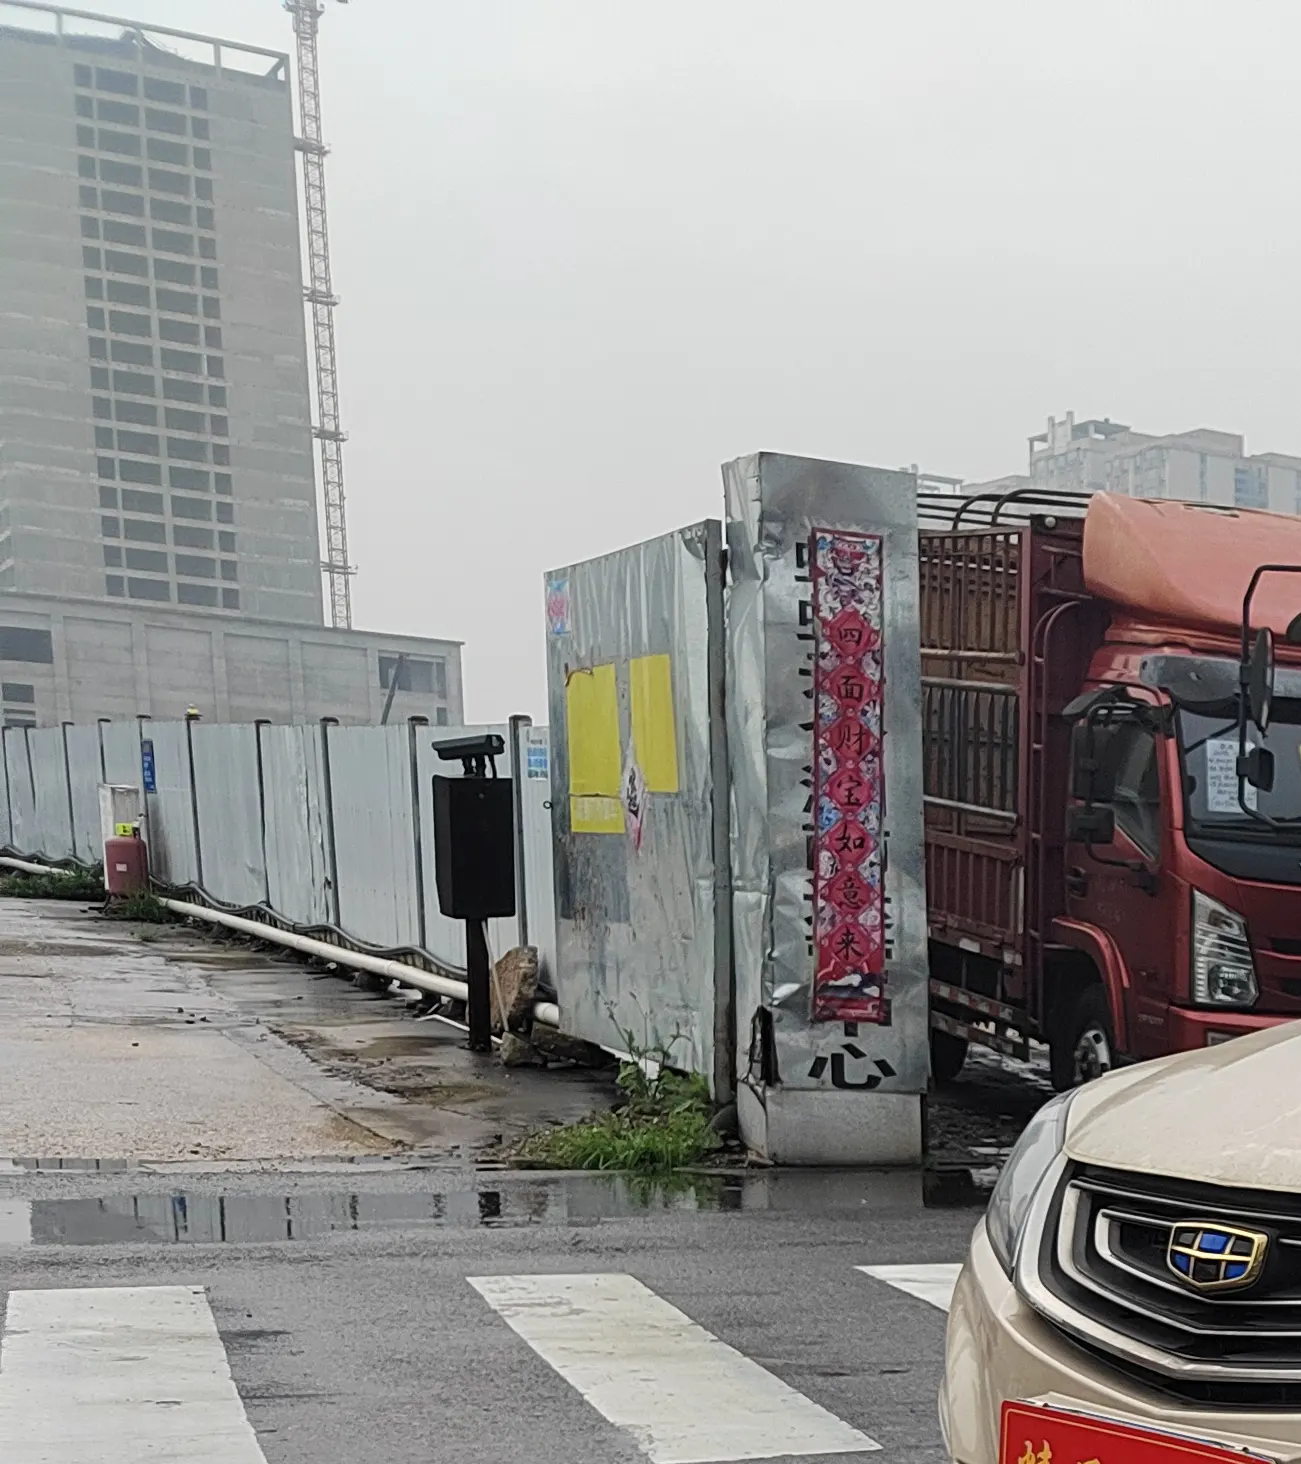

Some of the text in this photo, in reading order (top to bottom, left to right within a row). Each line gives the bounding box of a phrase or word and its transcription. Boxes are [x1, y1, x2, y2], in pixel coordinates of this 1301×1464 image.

[835, 626, 867, 960] 四面财宝如意来
